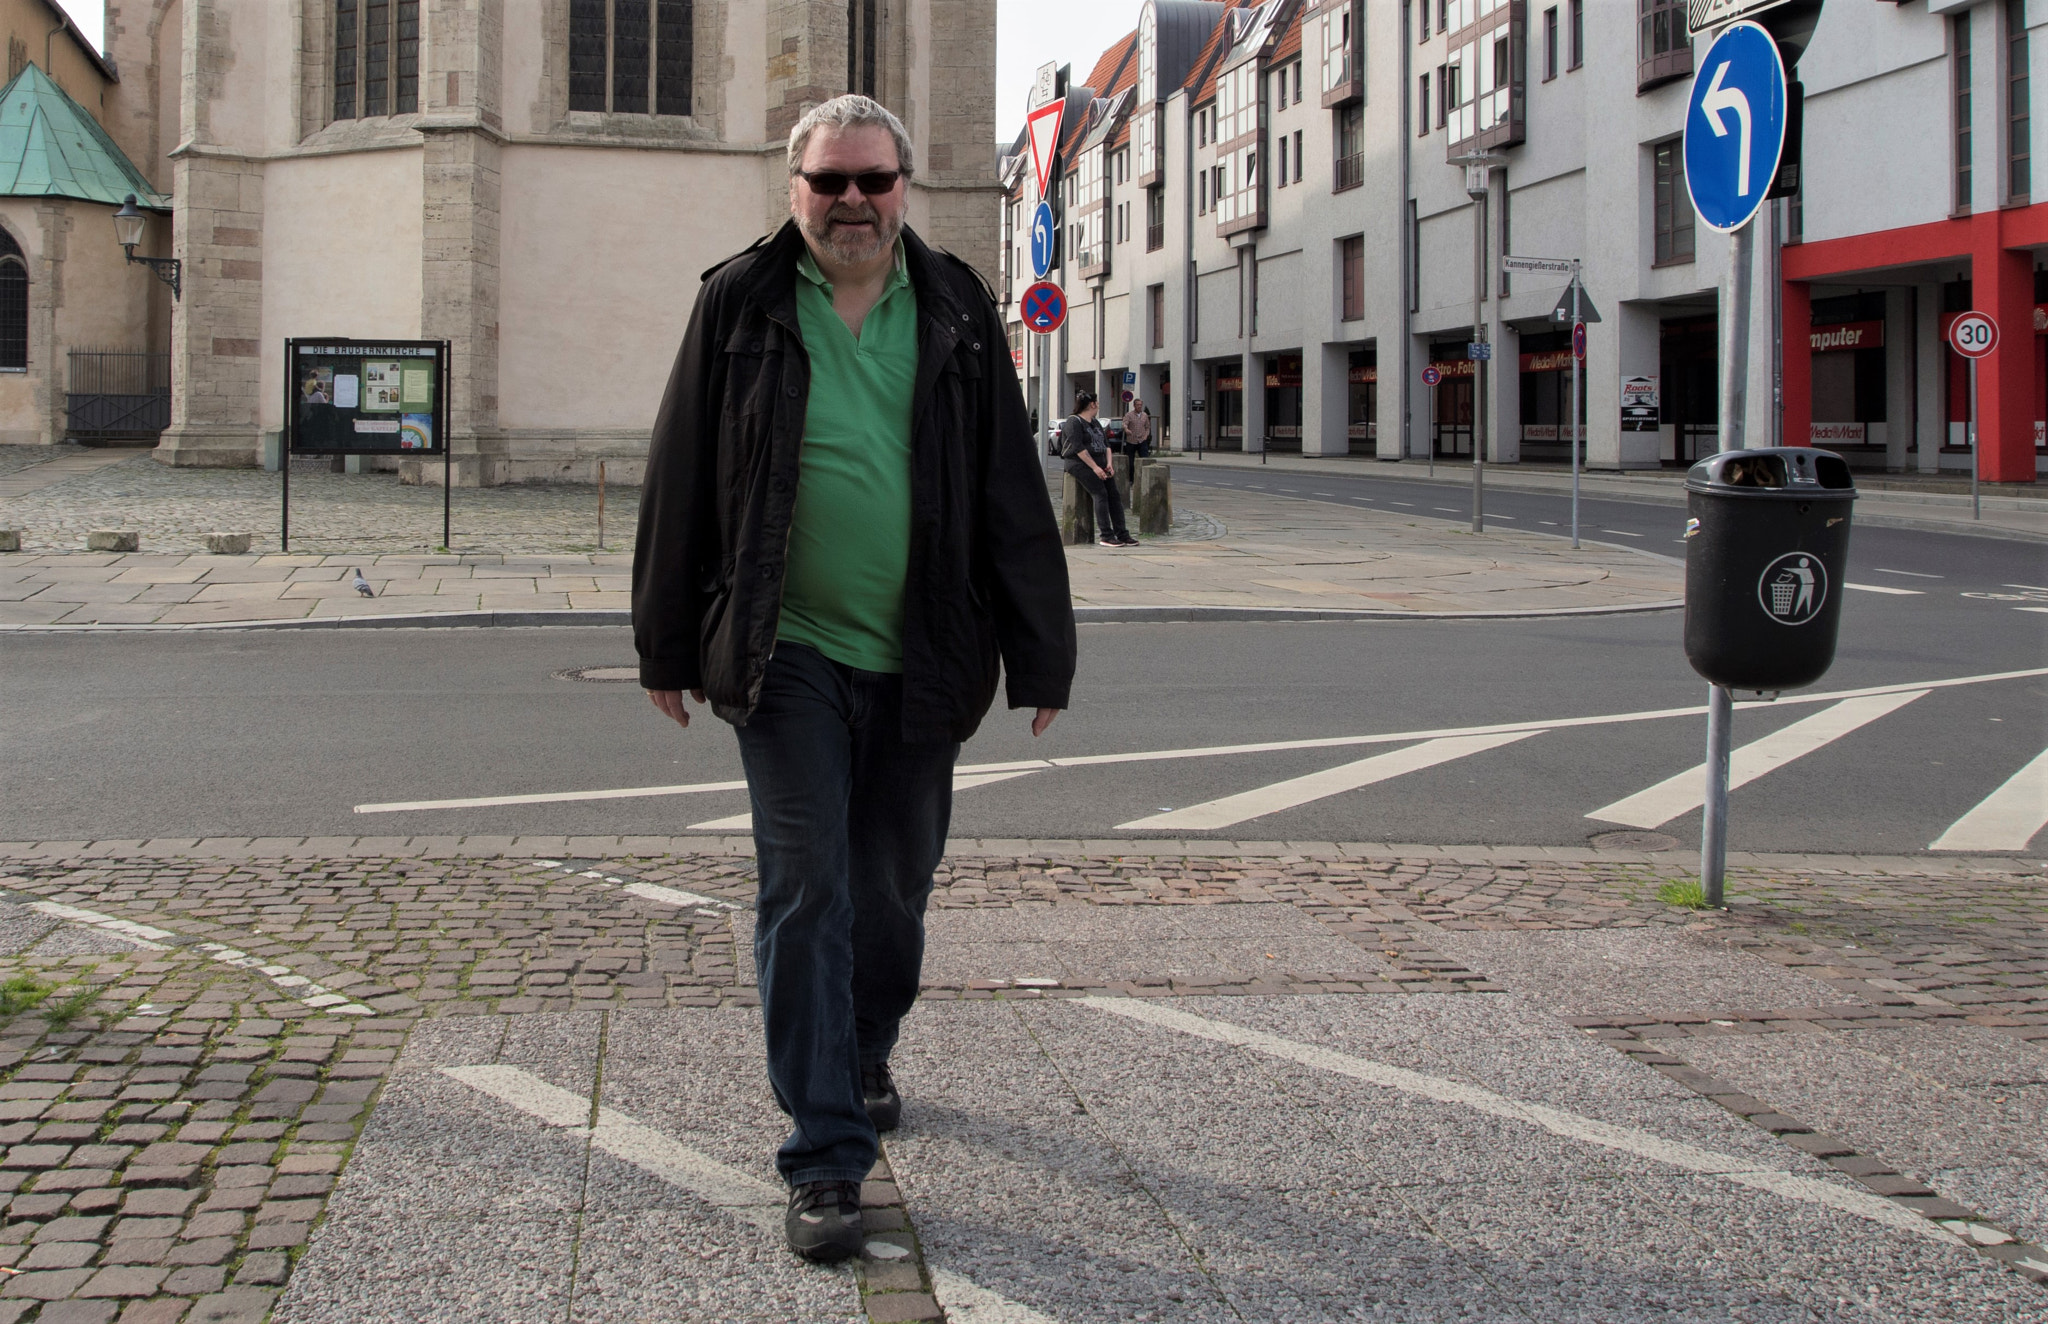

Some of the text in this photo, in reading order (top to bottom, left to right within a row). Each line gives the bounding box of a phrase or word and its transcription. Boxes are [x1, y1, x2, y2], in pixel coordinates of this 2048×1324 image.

[1505, 259, 1569, 272] Kannengießerstraße
[1960, 324, 1988, 345] 30
[313, 345, 328, 354] DIE
[1125, 373, 1134, 383] P
[1623, 384, 1653, 395] Roots
